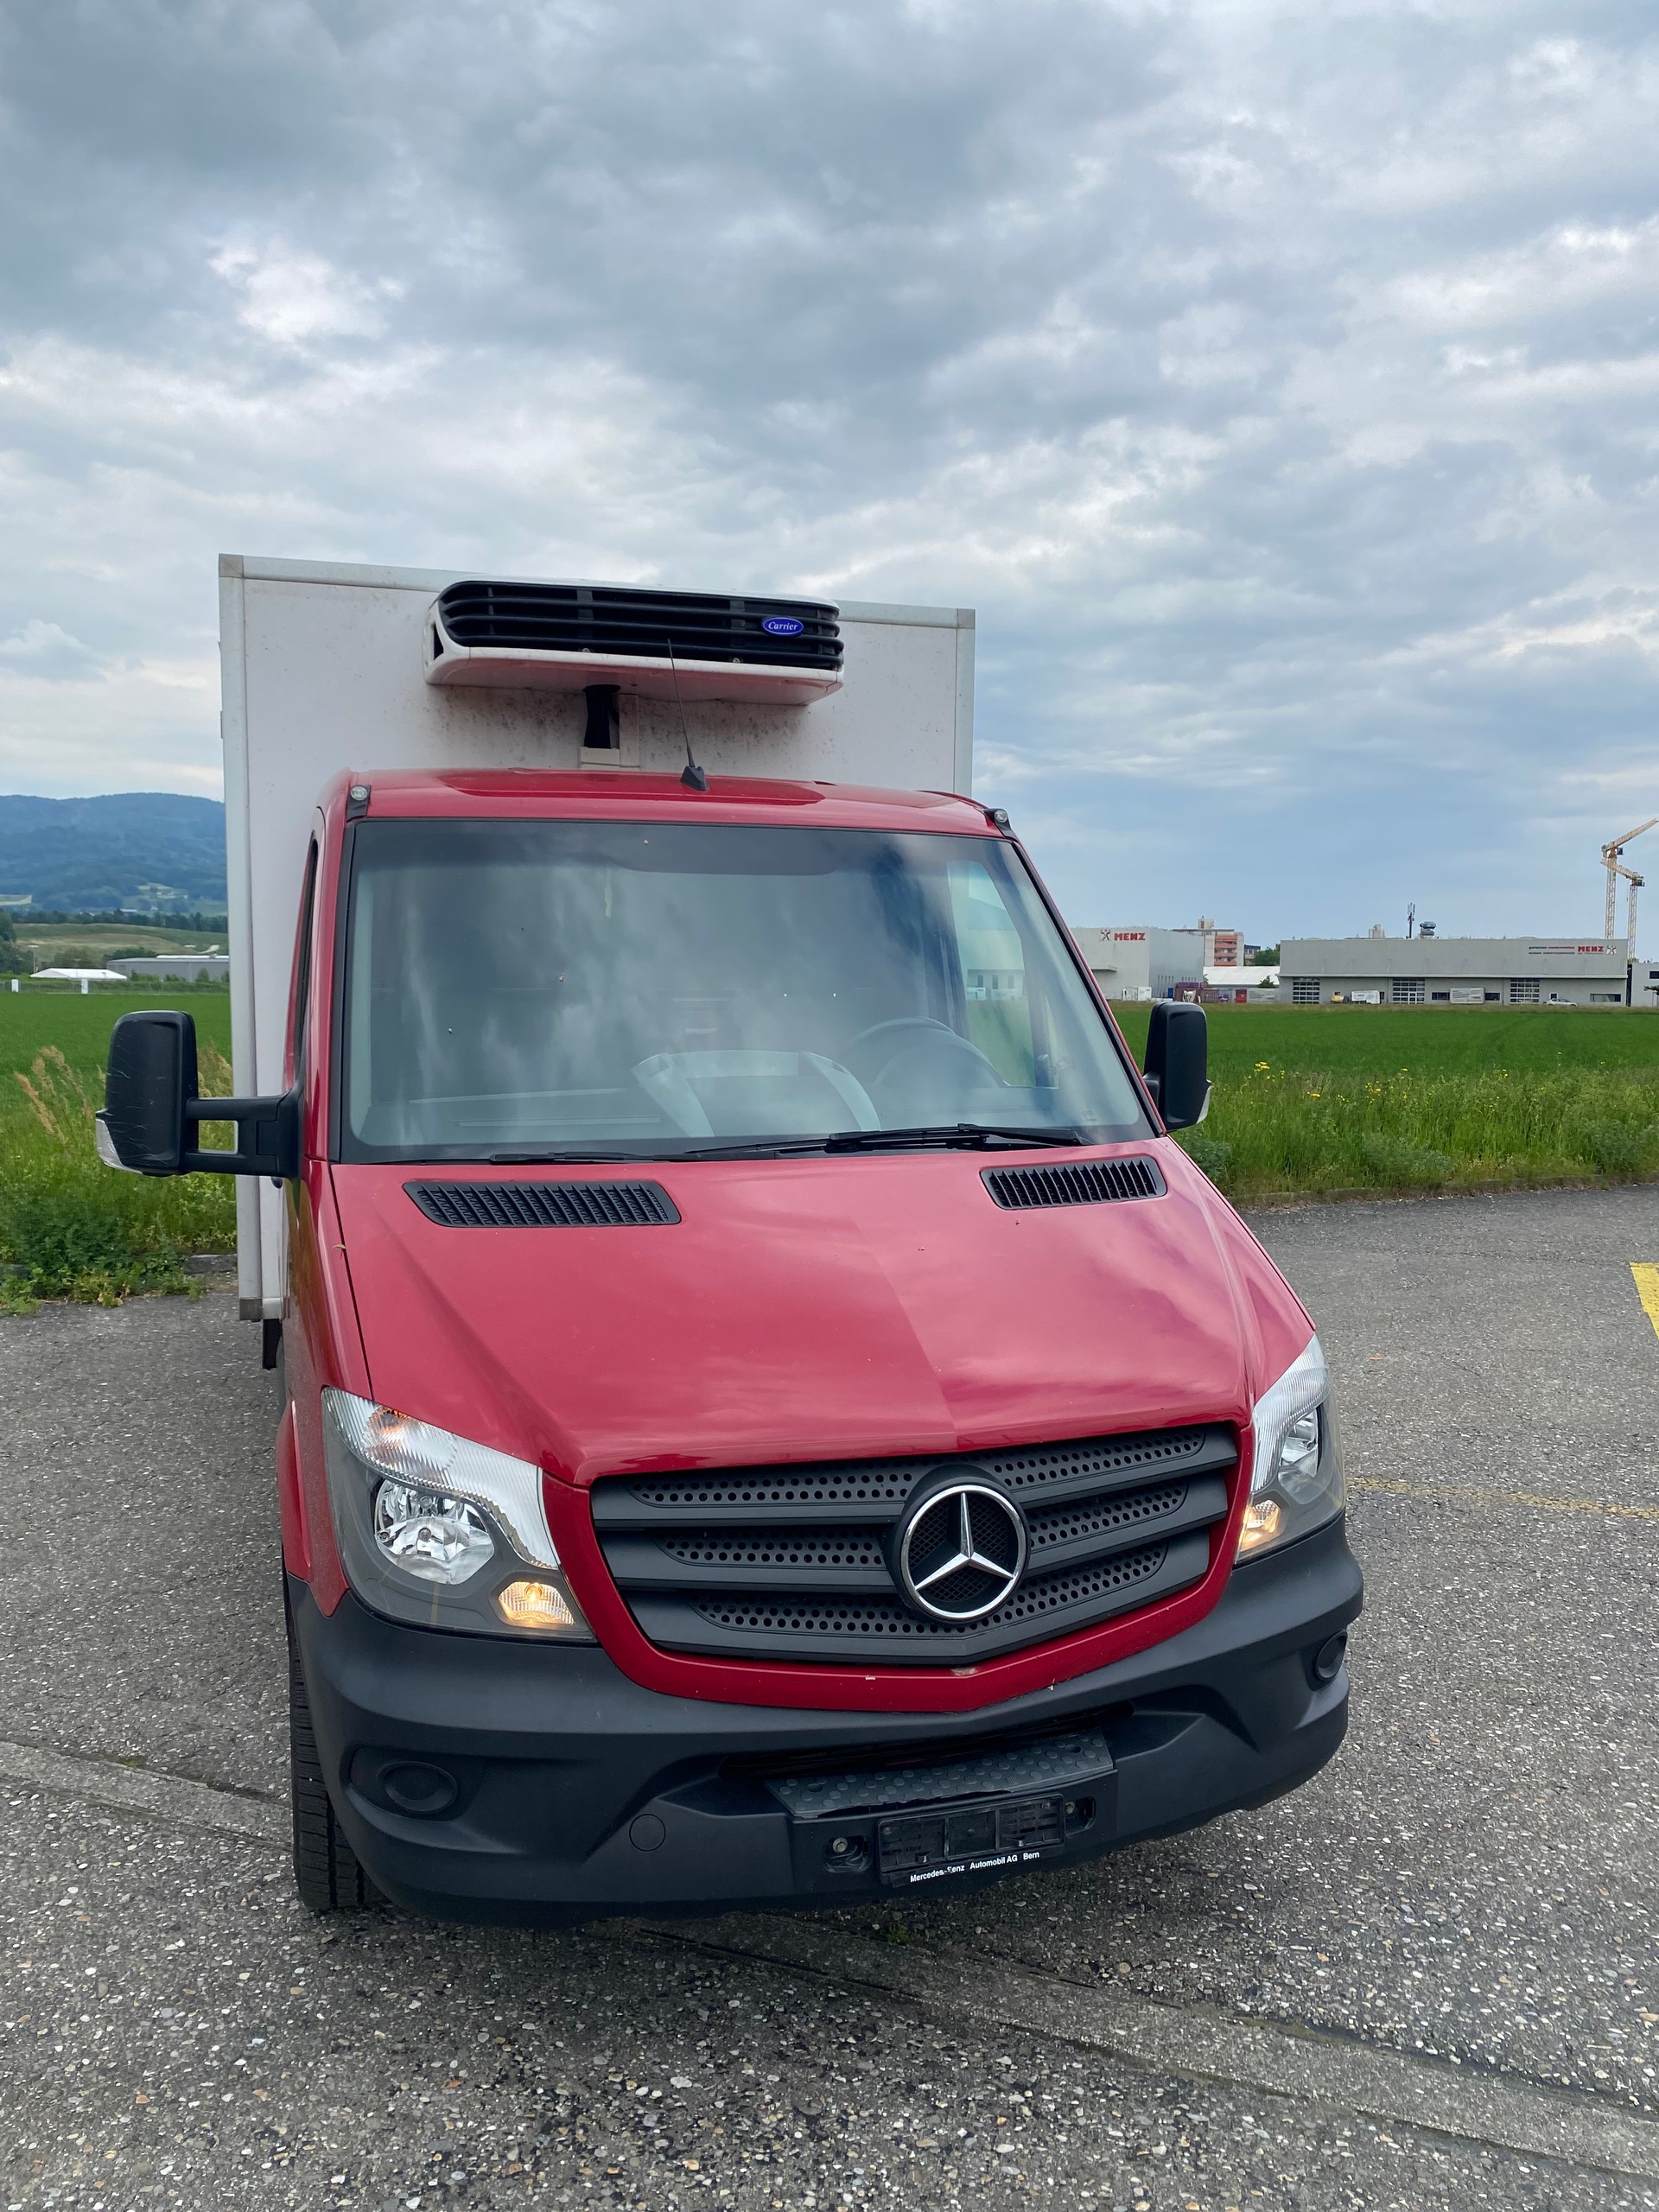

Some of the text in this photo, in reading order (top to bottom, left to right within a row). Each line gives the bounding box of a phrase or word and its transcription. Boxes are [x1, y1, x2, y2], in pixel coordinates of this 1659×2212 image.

[768, 621, 798, 630] Carrier
[1114, 932, 1146, 941] MENZ
[969, 1856, 1006, 1870] Automobil
[1006, 1854, 1018, 1863] AG
[1023, 1852, 1039, 1860] Bern
